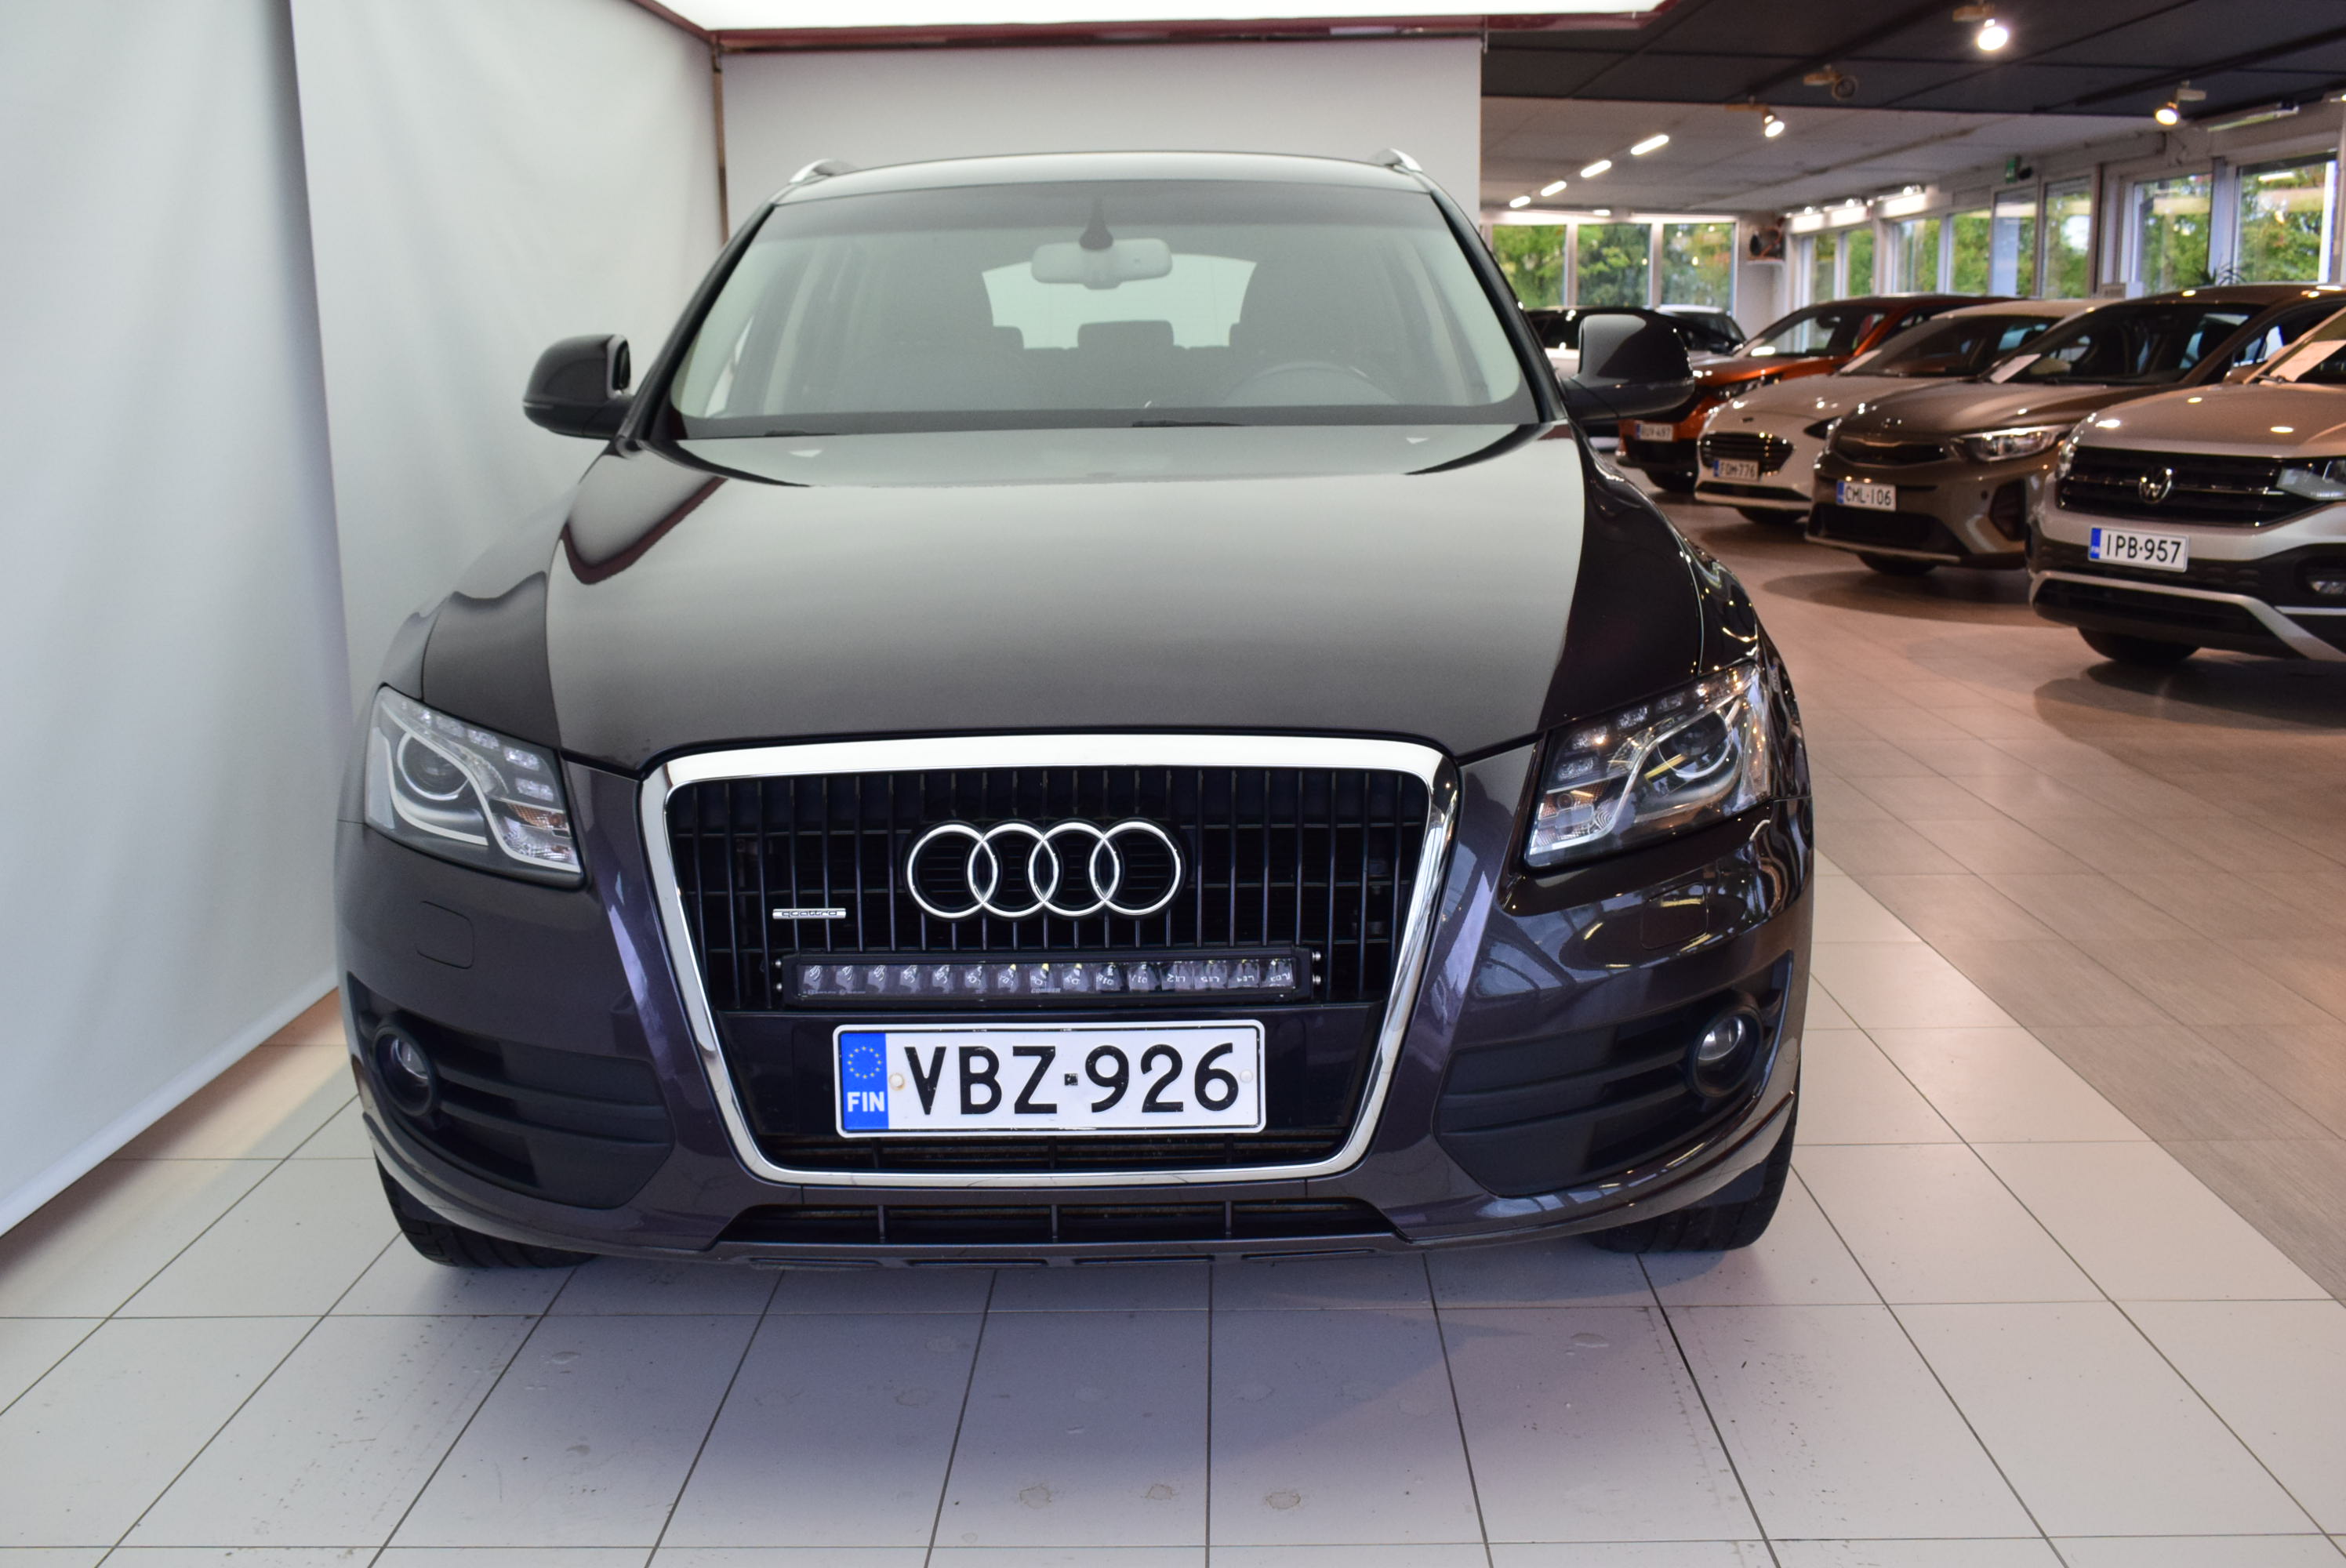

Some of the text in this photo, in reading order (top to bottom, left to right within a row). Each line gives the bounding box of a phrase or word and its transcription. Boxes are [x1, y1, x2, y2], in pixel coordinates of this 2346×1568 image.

[1845, 485, 1892, 506] CML-106
[2107, 534, 2182, 564] IPB-957
[781, 909, 837, 918] quattro
[904, 1042, 1239, 1115] VBZ-926
[847, 1091, 885, 1112] FIN
